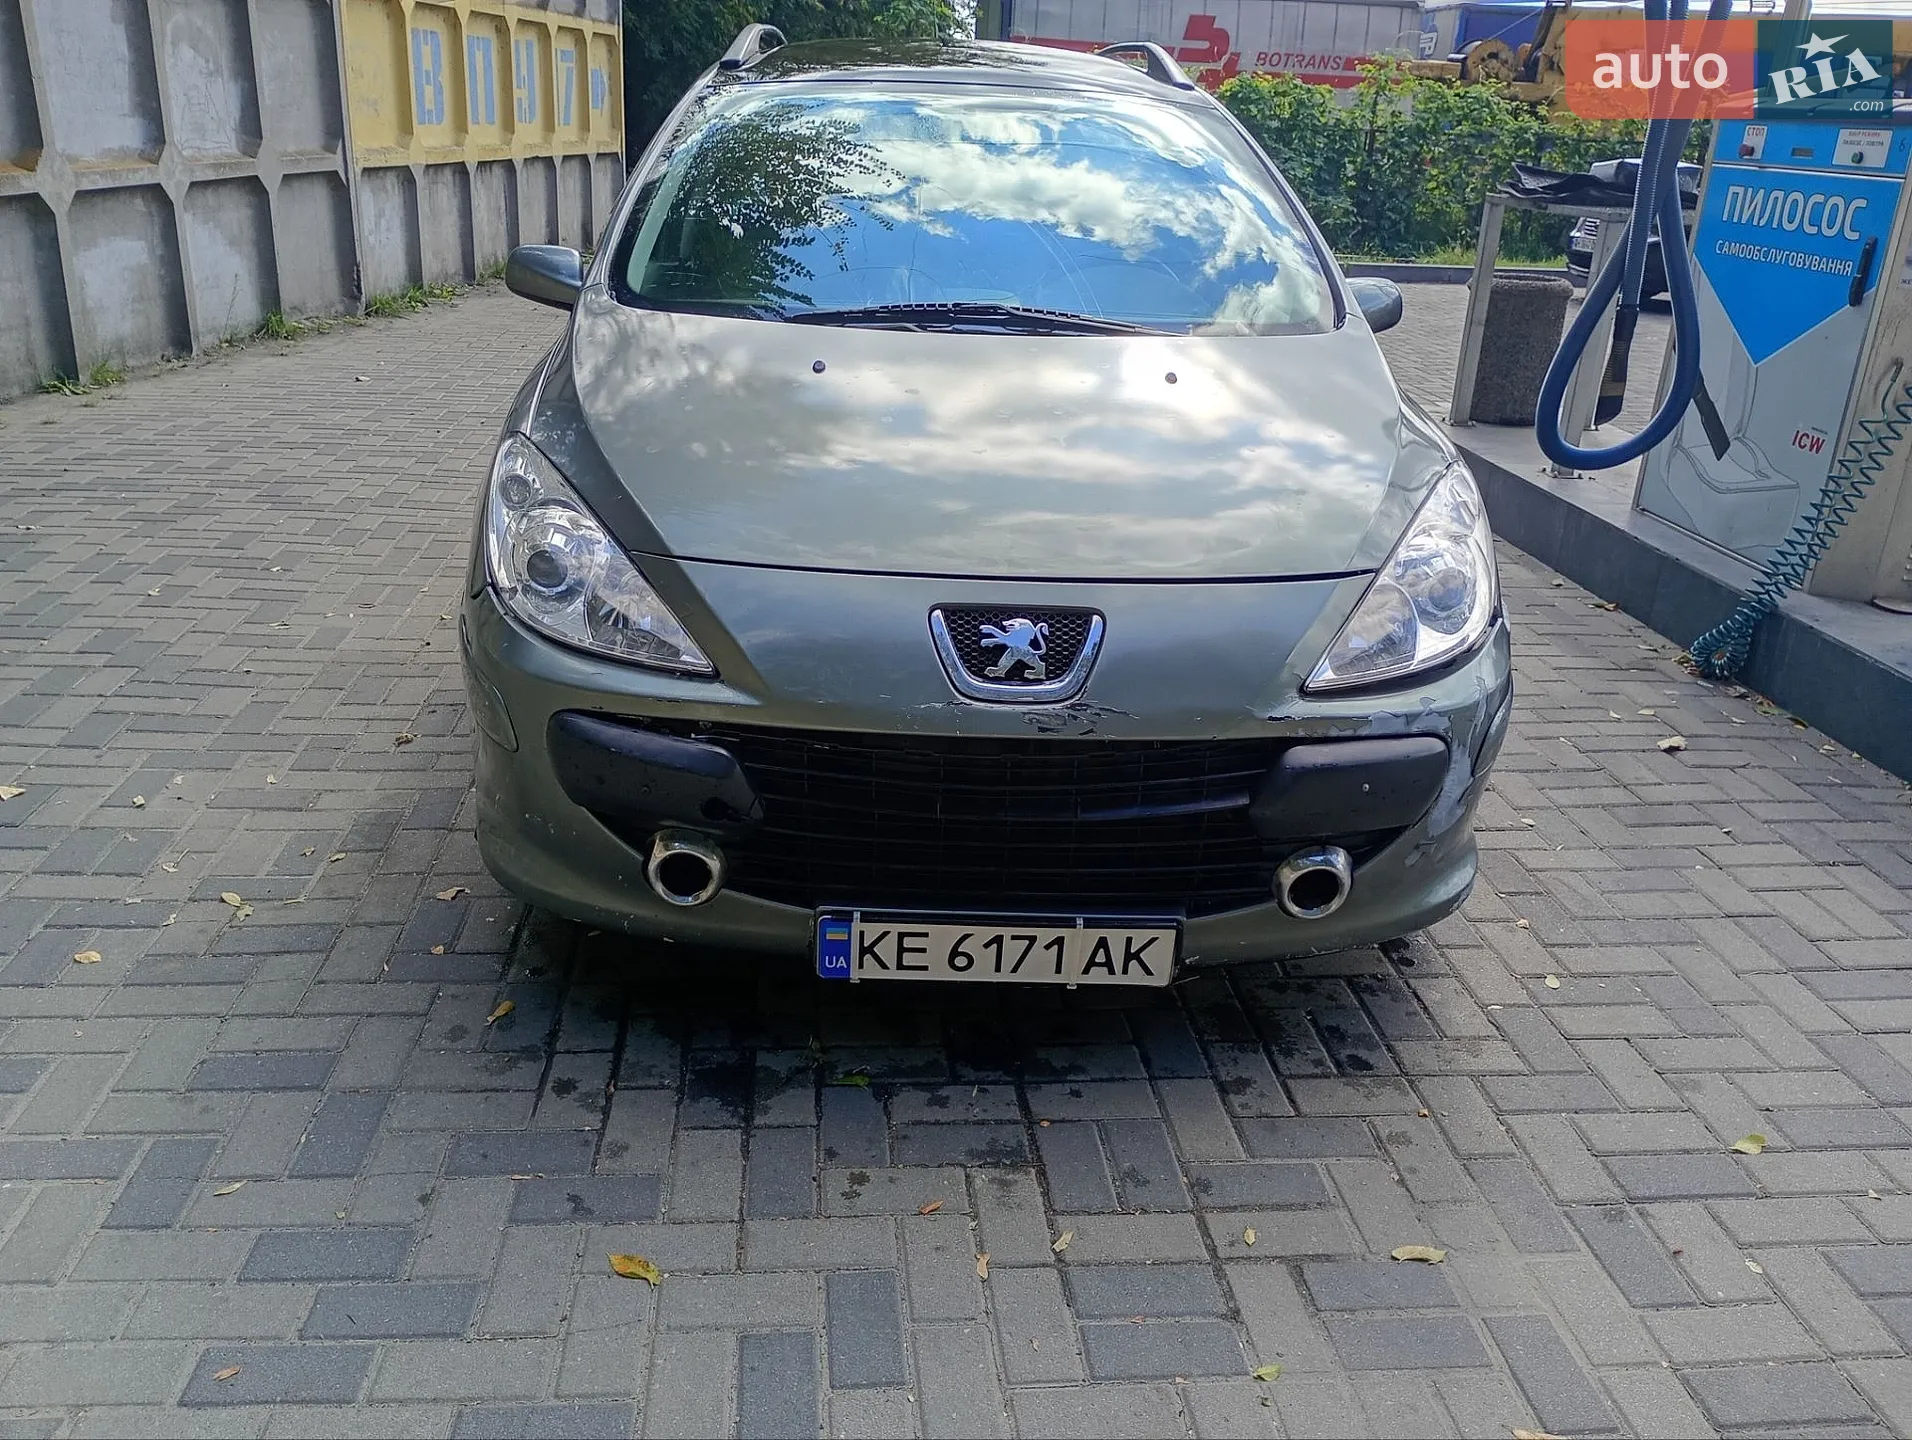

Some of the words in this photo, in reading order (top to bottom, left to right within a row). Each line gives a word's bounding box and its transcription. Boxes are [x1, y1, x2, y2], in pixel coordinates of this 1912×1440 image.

[1255, 51, 1342, 72] BOTRANS
[1722, 184, 1868, 241] ПИЛОСОС
[1715, 239, 1854, 277] САМООБСЛУГОВУВАННЯ
[1792, 429, 1826, 455] ICW
[825, 955, 848, 969] UA
[858, 930, 930, 971] KE
[947, 932, 1066, 975] 6171
[1081, 936, 1160, 977] AK
